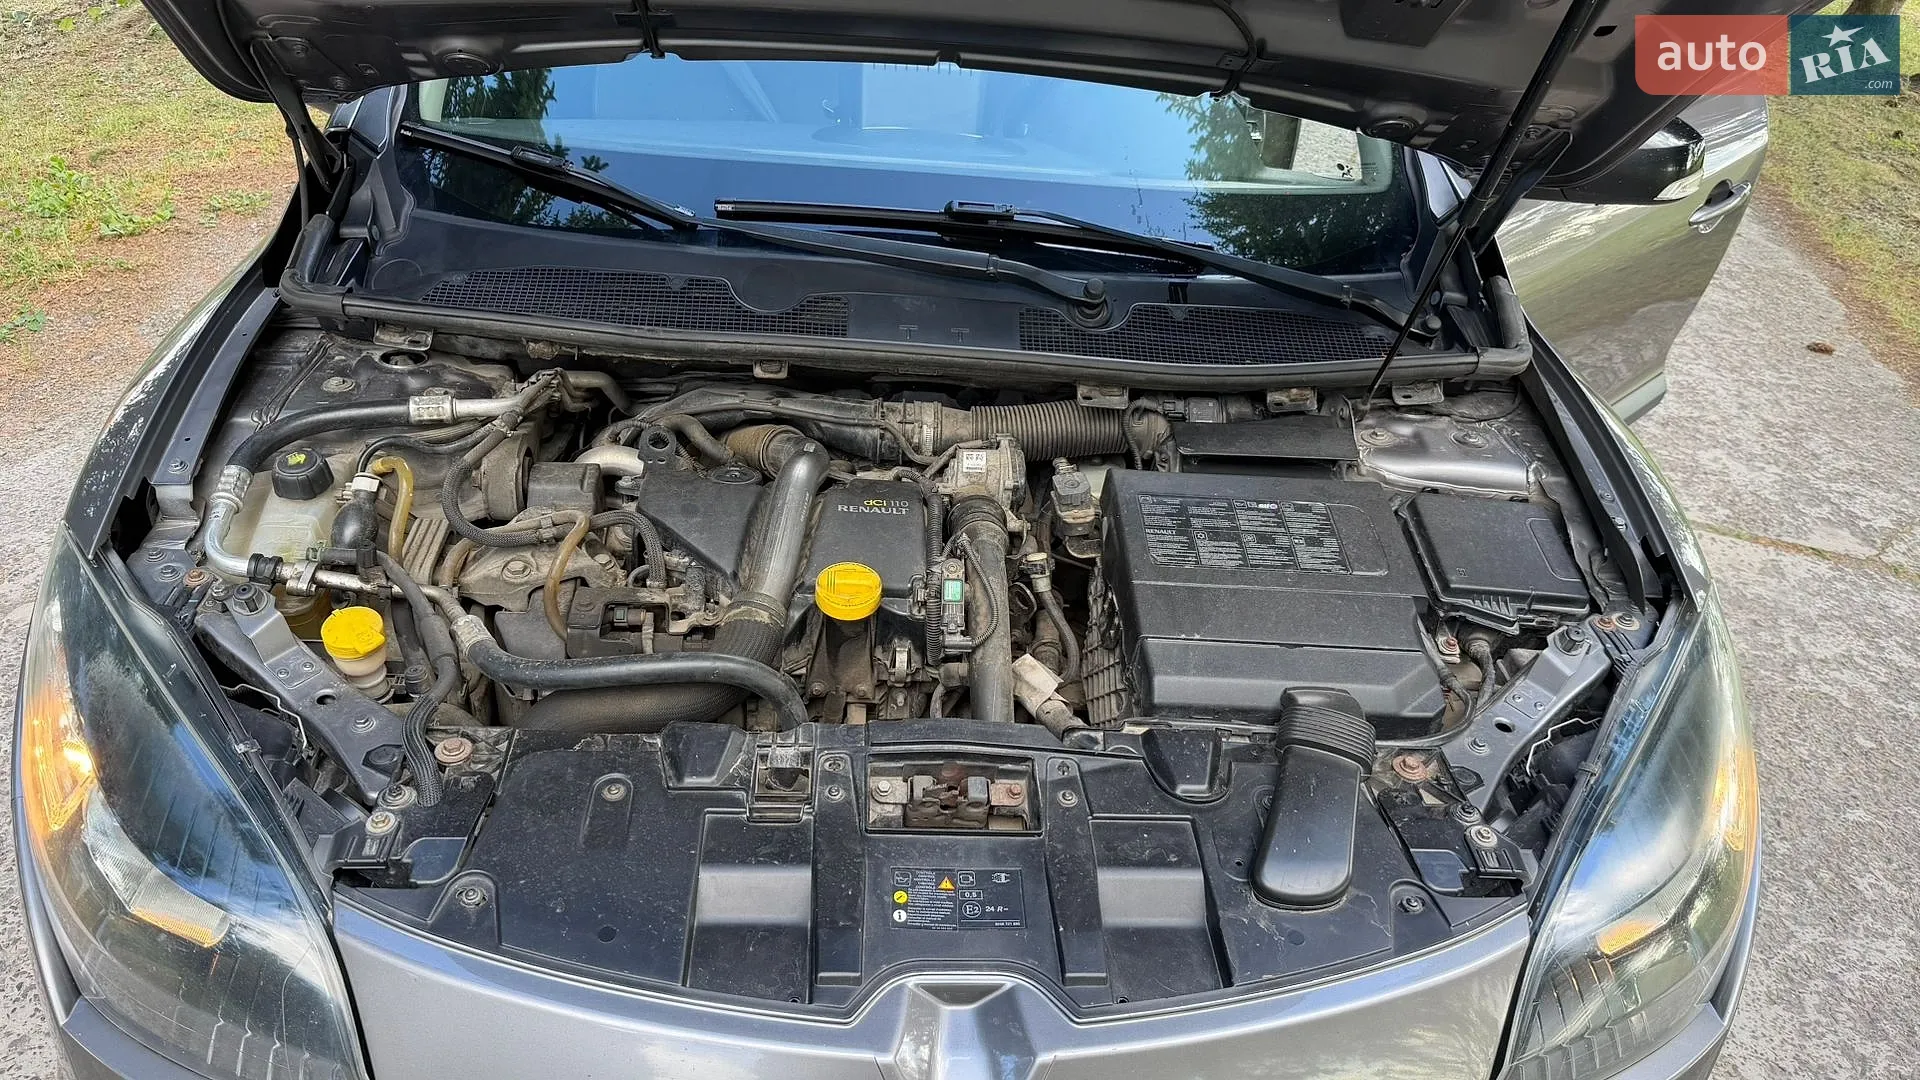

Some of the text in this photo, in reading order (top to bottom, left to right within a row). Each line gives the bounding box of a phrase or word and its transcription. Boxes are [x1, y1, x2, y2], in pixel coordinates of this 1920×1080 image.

[837, 504, 910, 515] RENAULT
[965, 904, 980, 915] E2
[985, 905, 995, 913] 24
